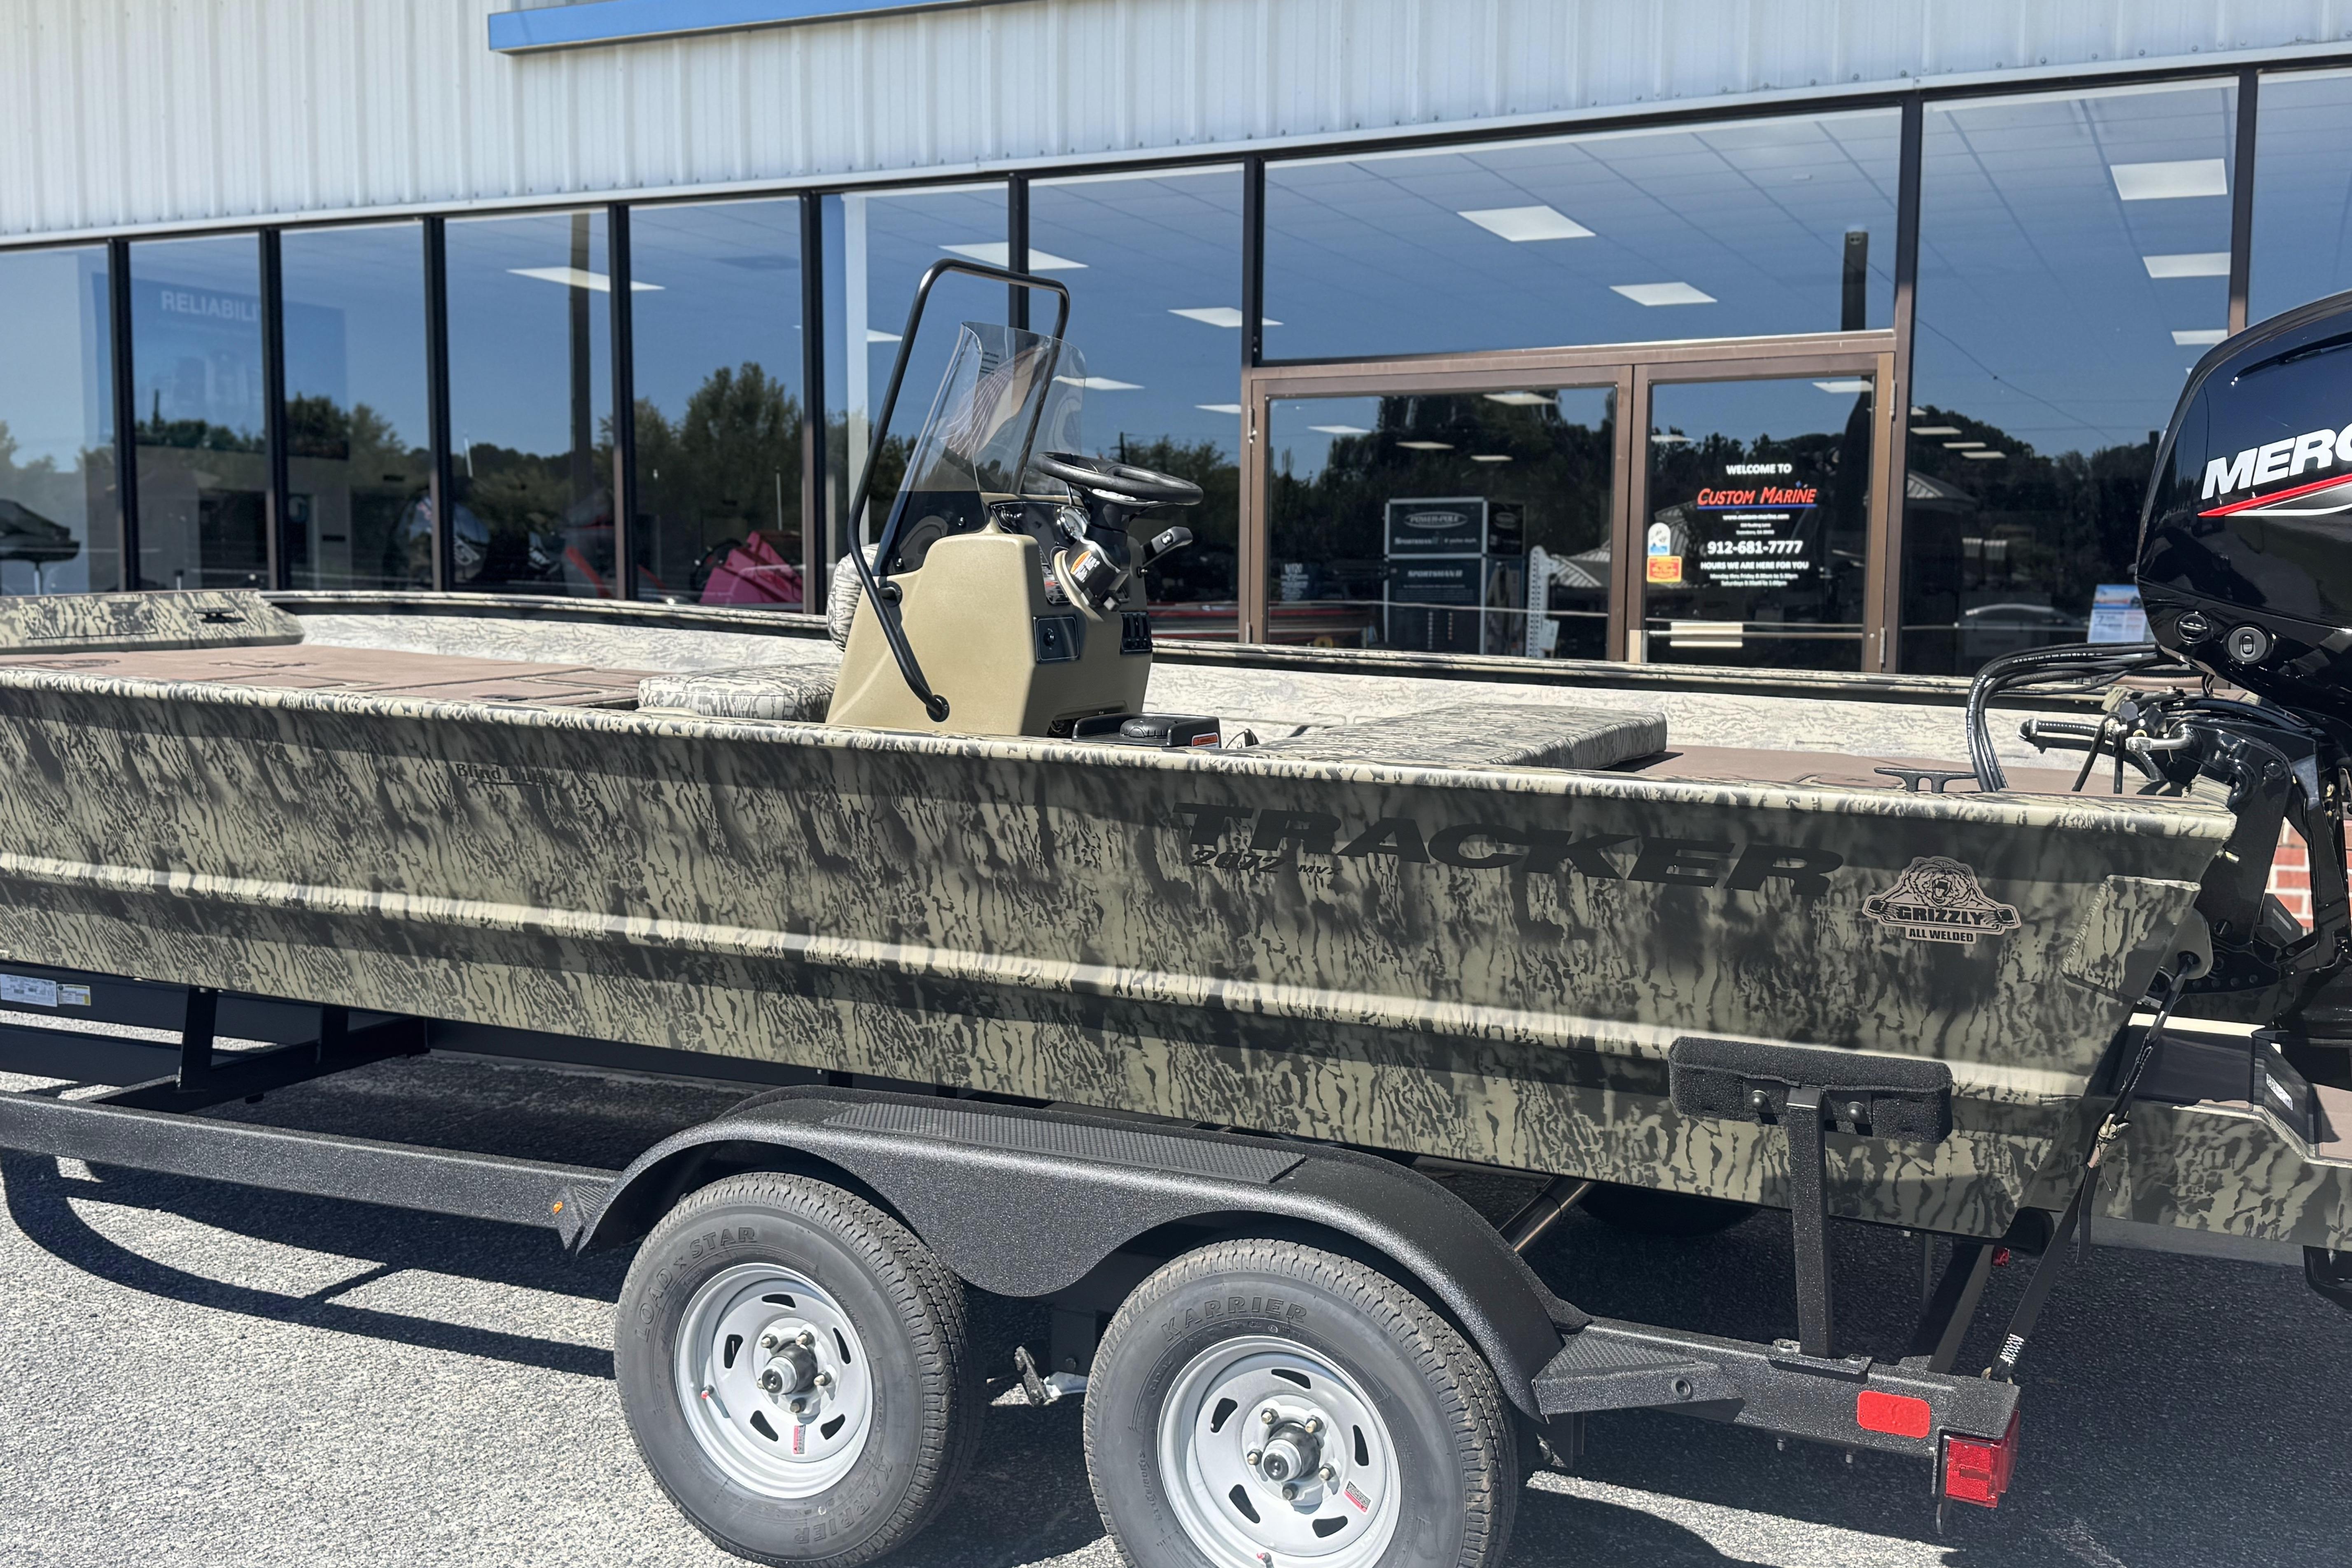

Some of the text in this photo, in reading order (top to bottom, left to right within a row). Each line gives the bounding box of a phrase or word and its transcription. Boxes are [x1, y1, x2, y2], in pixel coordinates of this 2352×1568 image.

[161, 290, 260, 322] RELIABILI
[1726, 463, 1792, 474] WELCOME TO
[1707, 540, 1803, 555] 912-681-7777
[1700, 562, 1727, 570] HOURS
[1756, 561, 1775, 569] HERE
[1776, 561, 1792, 569] FOR
[1792, 561, 1809, 569] YOU
[1173, 802, 1844, 897] TRACKER
[1189, 849, 1286, 873] 2072
[1898, 905, 1984, 925] GRIZZLY
[1909, 928, 1974, 942] ALL WELDED
[635, 1227, 757, 1343] LOAD STAR
[1161, 1295, 1307, 1342] KARRIER
[794, 1455, 893, 1544] KARRIER
